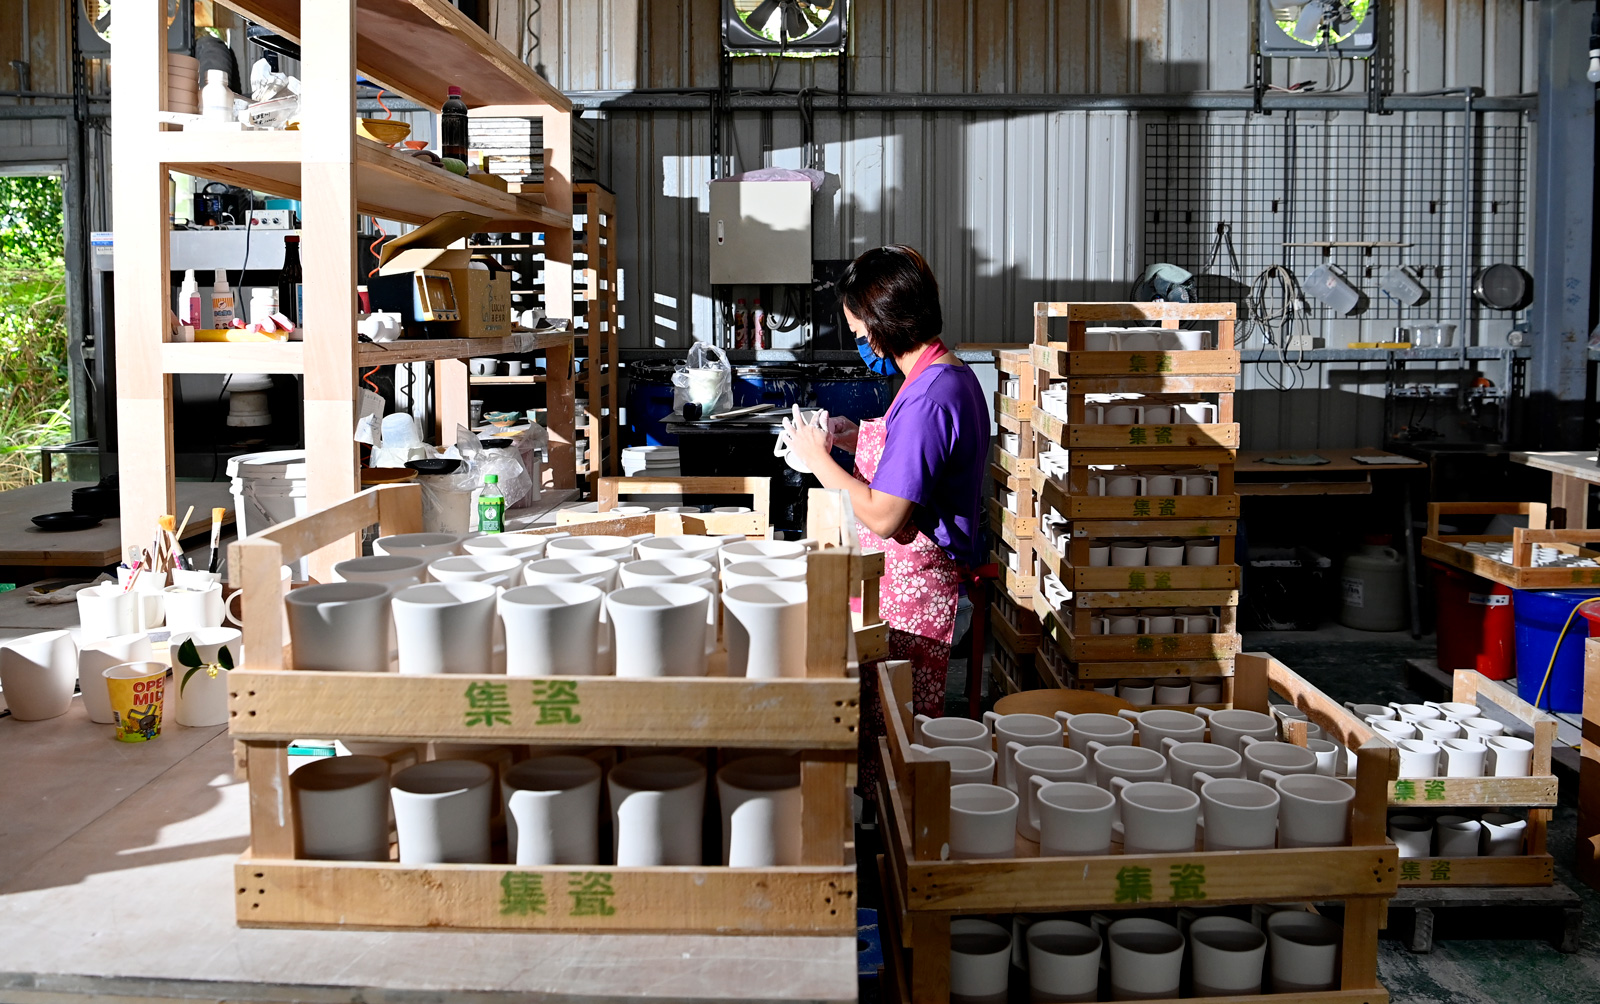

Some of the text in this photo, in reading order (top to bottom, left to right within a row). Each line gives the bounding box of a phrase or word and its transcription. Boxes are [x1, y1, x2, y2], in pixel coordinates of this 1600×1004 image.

[1129, 426, 1172, 445] 集瓷
[1133, 499, 1176, 516] 集瓷
[133, 676, 165, 693] OPE
[133, 689, 164, 706] MIL
[464, 680, 581, 727] 集瓷
[1394, 780, 1446, 801] 集瓷
[1400, 860, 1451, 881] 集瓷
[499, 871, 615, 916] 集瓷
[1115, 864, 1207, 902] 集瓷
